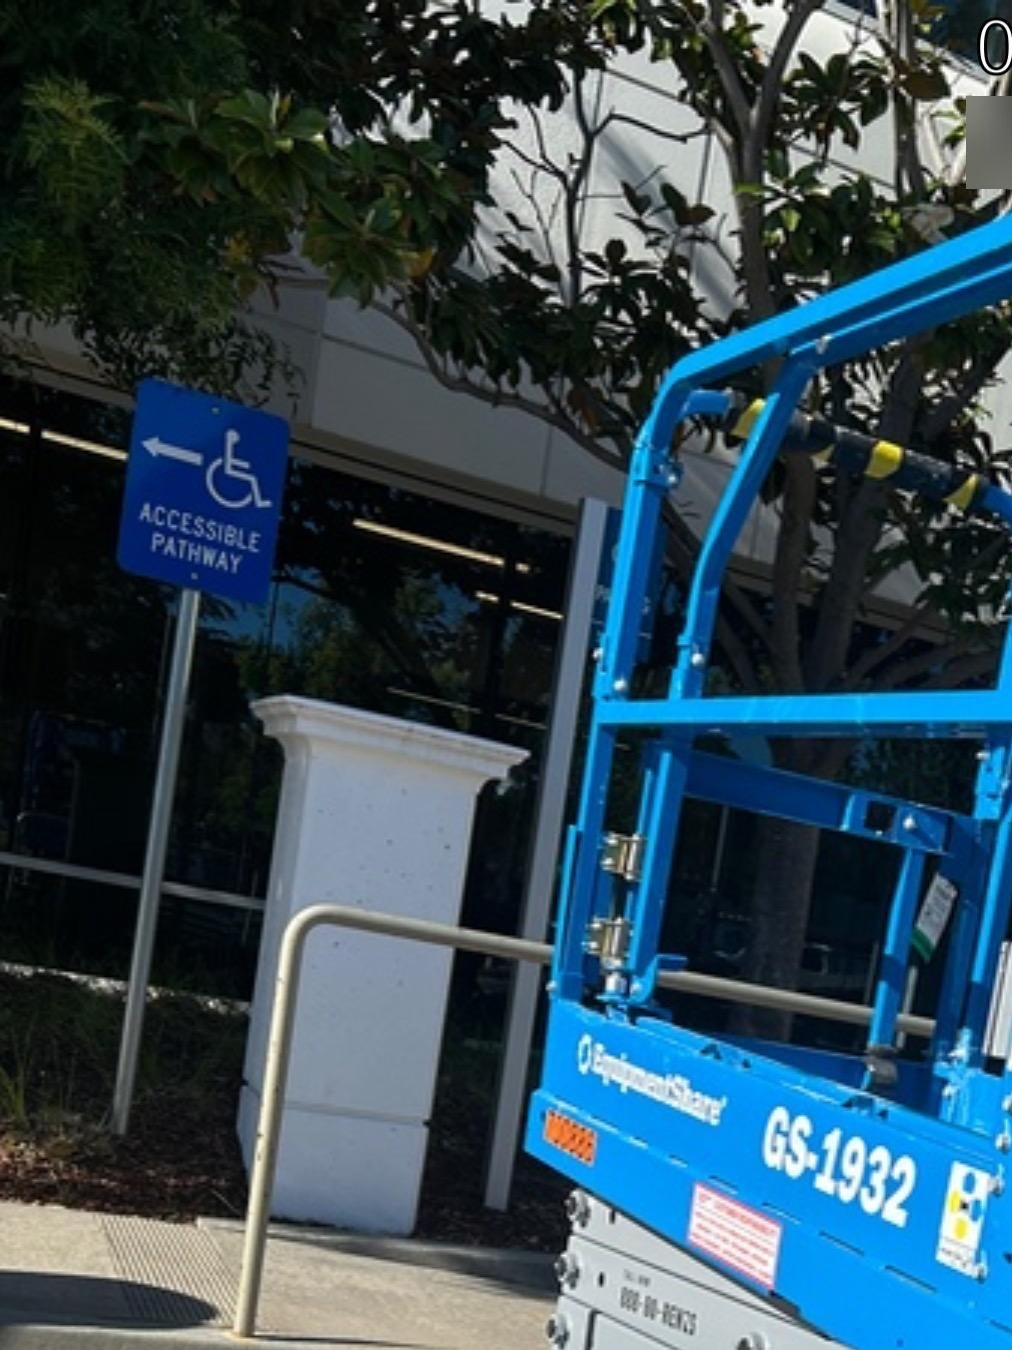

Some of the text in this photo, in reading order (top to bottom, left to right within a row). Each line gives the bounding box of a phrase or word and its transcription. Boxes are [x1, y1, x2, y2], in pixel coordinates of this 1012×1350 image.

[138, 502, 261, 553] ACCESSIBLE
[151, 533, 243, 574] PATHWAY
[590, 1042, 724, 1127] EquipmentShare
[763, 1105, 917, 1229] GS-1932
